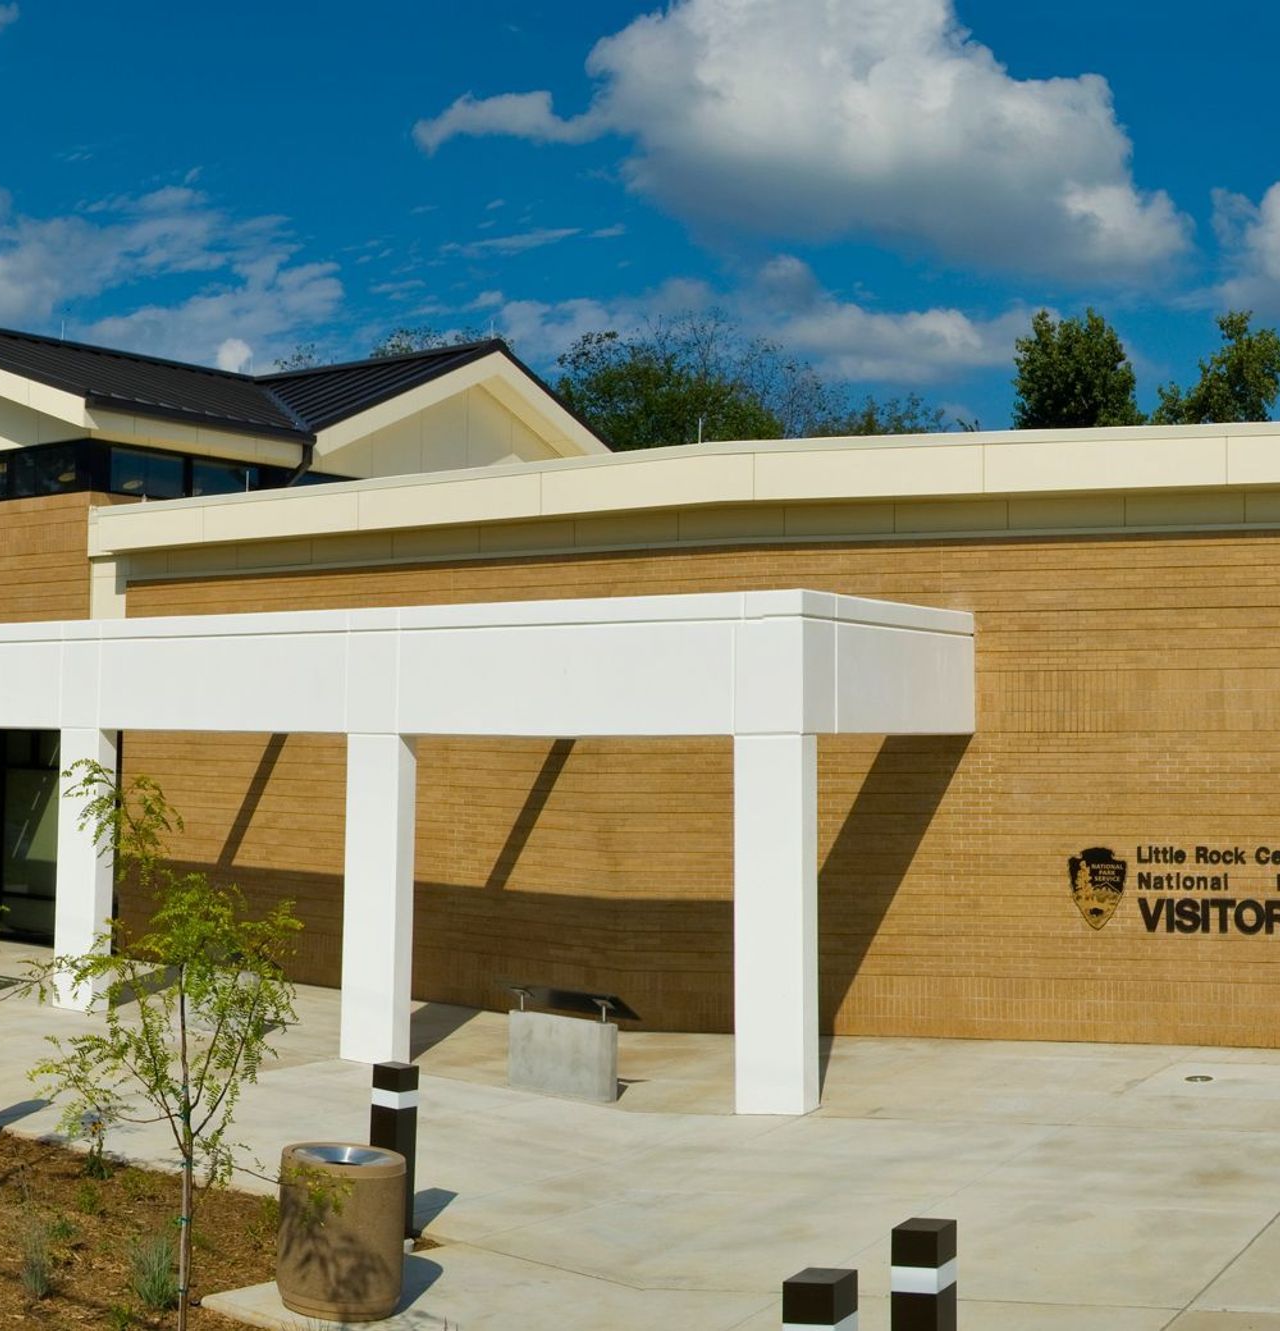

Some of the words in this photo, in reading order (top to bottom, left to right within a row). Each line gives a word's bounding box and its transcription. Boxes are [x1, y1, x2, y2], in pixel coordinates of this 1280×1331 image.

[1136, 846, 1187, 864] Little
[1195, 846, 1247, 865] Rock
[1137, 872, 1229, 891] National
